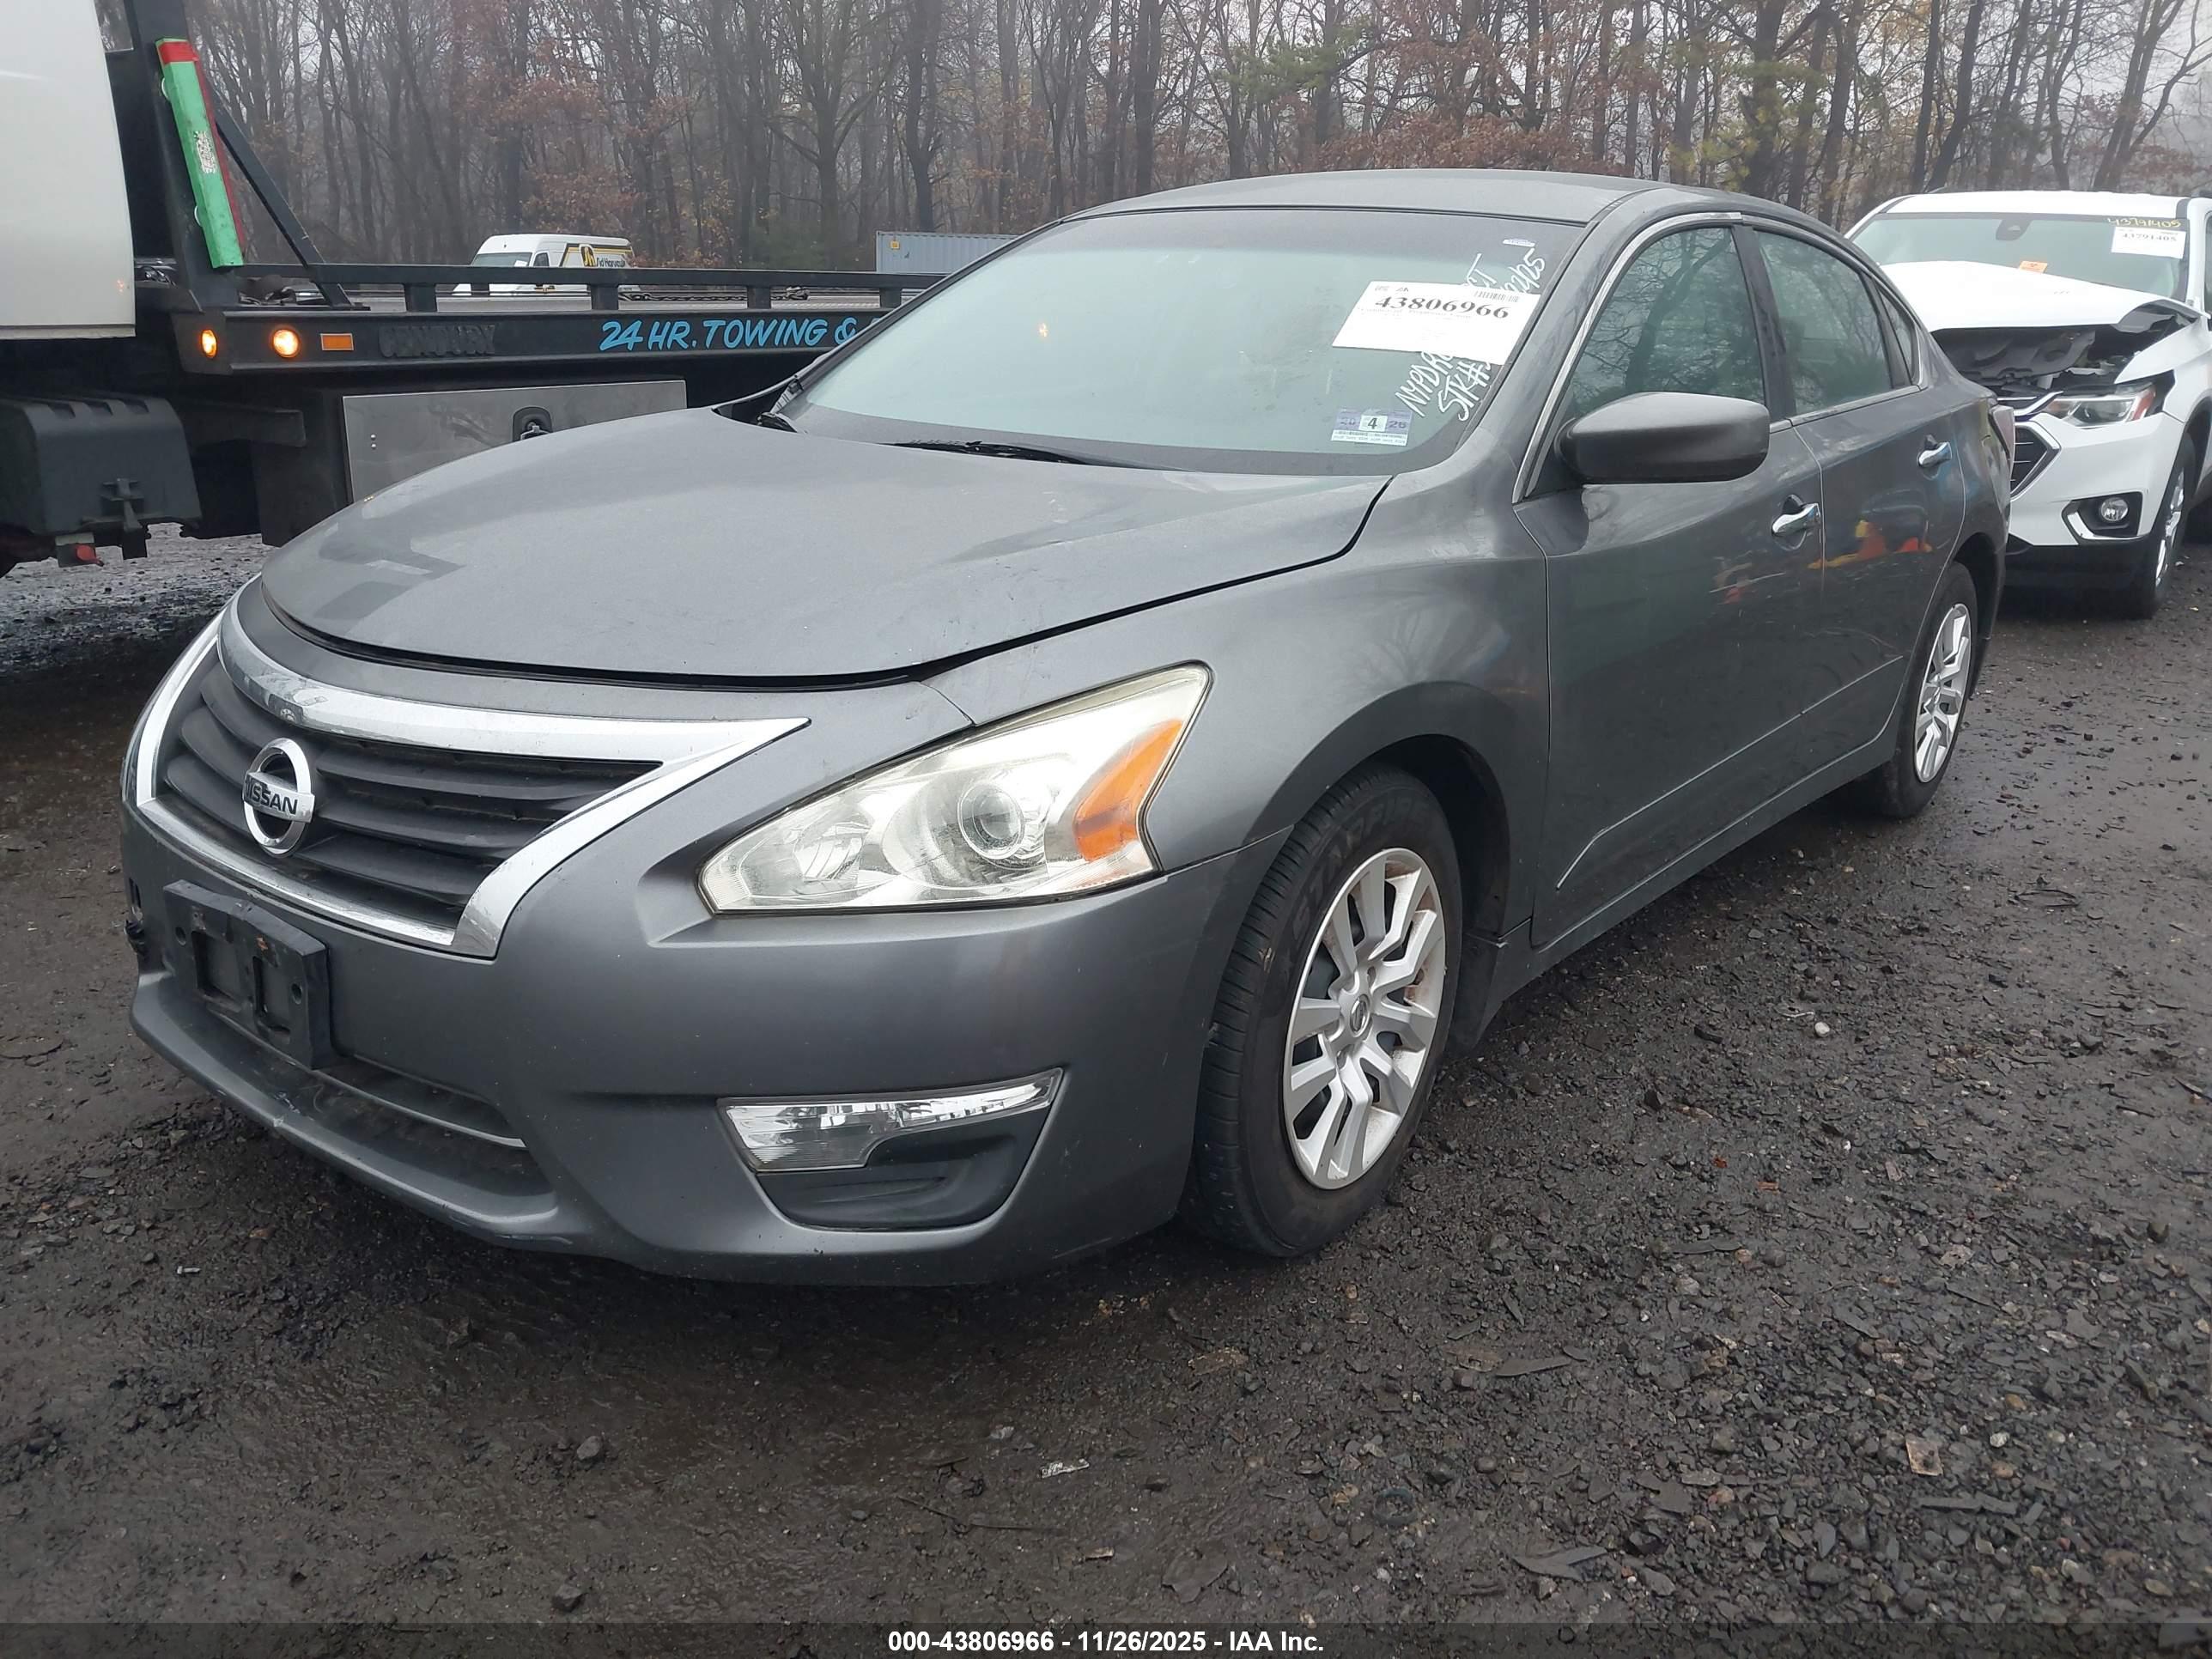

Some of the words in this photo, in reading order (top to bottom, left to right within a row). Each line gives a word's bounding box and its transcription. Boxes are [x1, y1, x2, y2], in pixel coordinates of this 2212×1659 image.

[2107, 216, 2182, 228] 43791405
[1374, 295, 1510, 319] 43806966
[599, 319, 644, 352] 24
[647, 320, 697, 351] HR.
[703, 318, 829, 349] TOWING
[834, 317, 857, 345] &
[1367, 417, 1378, 430] 4
[245, 775, 299, 815] NISSAN
